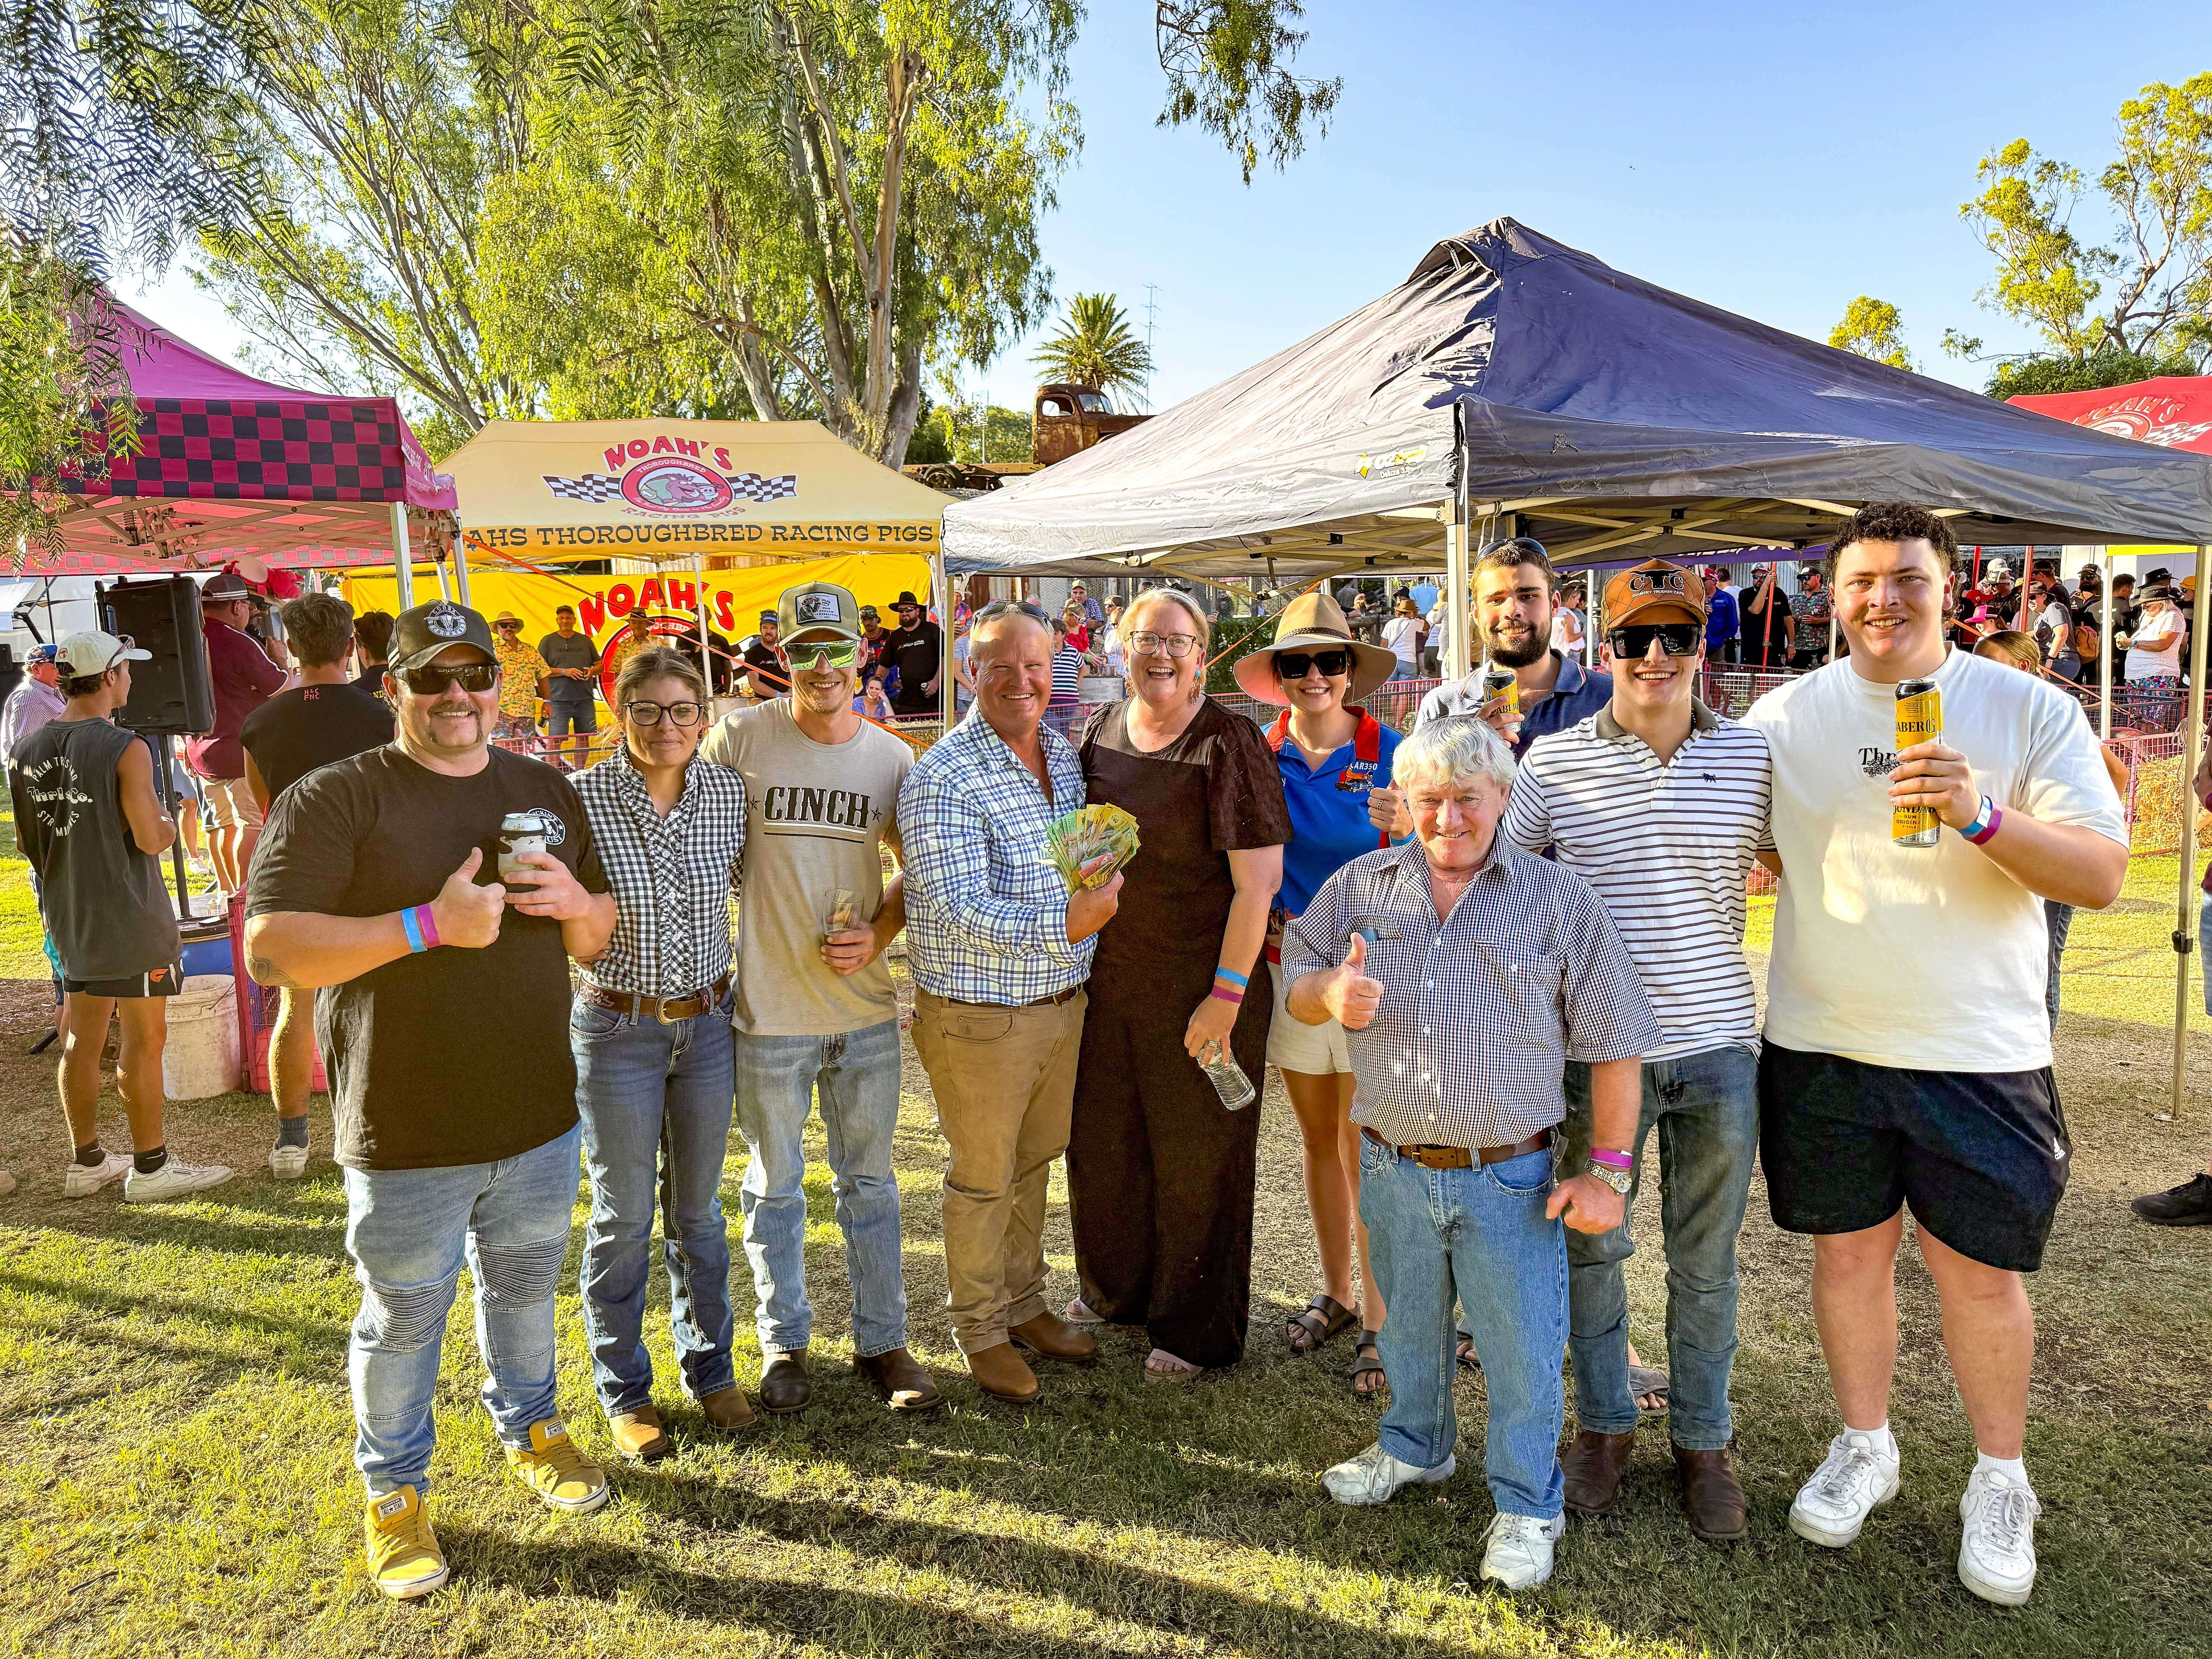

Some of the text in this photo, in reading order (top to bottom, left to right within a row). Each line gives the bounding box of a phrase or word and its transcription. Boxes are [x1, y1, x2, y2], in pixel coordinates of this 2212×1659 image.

[2072, 396, 2186, 425] NOAH'S
[602, 436, 733, 473] NOAH'S
[636, 459, 706, 474] THOROUGHBRED
[620, 507, 746, 519] RACING PIGS
[537, 524, 763, 545] THOROUGHBRED
[771, 525, 869, 541] RACING
[877, 526, 934, 541] PIGS
[579, 579, 735, 638] NOAH'S
[32, 759, 53, 781] PALM
[393, 1502, 403, 1510] STAR
